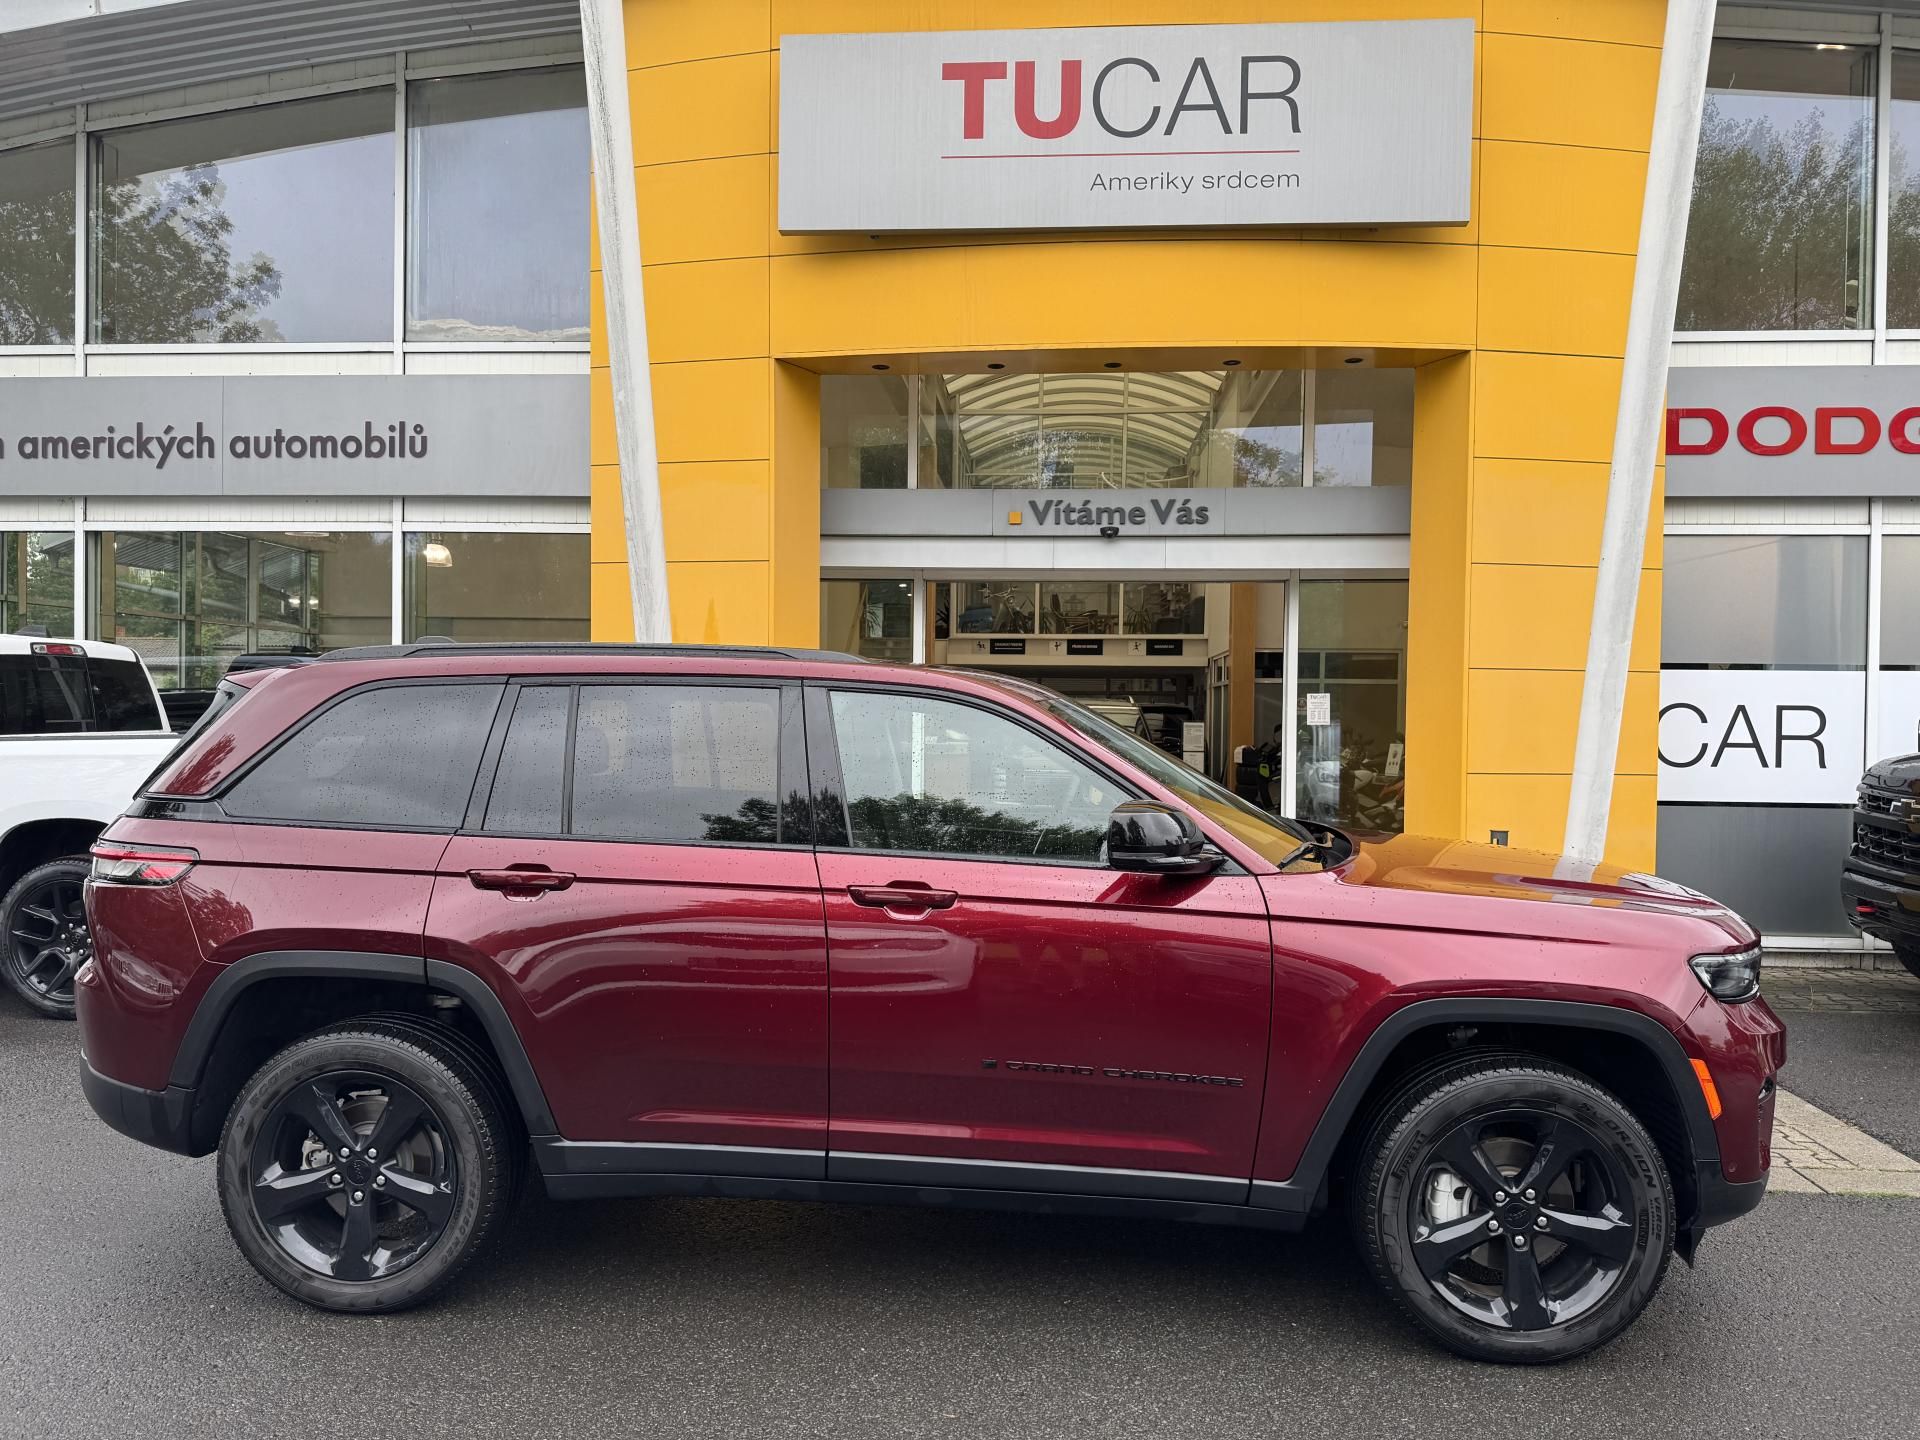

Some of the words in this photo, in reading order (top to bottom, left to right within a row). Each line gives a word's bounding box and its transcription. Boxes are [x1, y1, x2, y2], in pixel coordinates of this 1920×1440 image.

[942, 55, 1302, 141] TUCAR
[1089, 171, 1194, 194] Ameriky
[1201, 171, 1301, 190] srdcem
[17, 421, 216, 470] amerických
[229, 420, 429, 459] automobilů
[1027, 499, 1147, 526] Vítáme
[1150, 498, 1210, 526] Vás
[1657, 702, 1827, 769] CAR
[1005, 1060, 1096, 1076] GRAND
[1103, 1067, 1244, 1088] CHEROKEE
